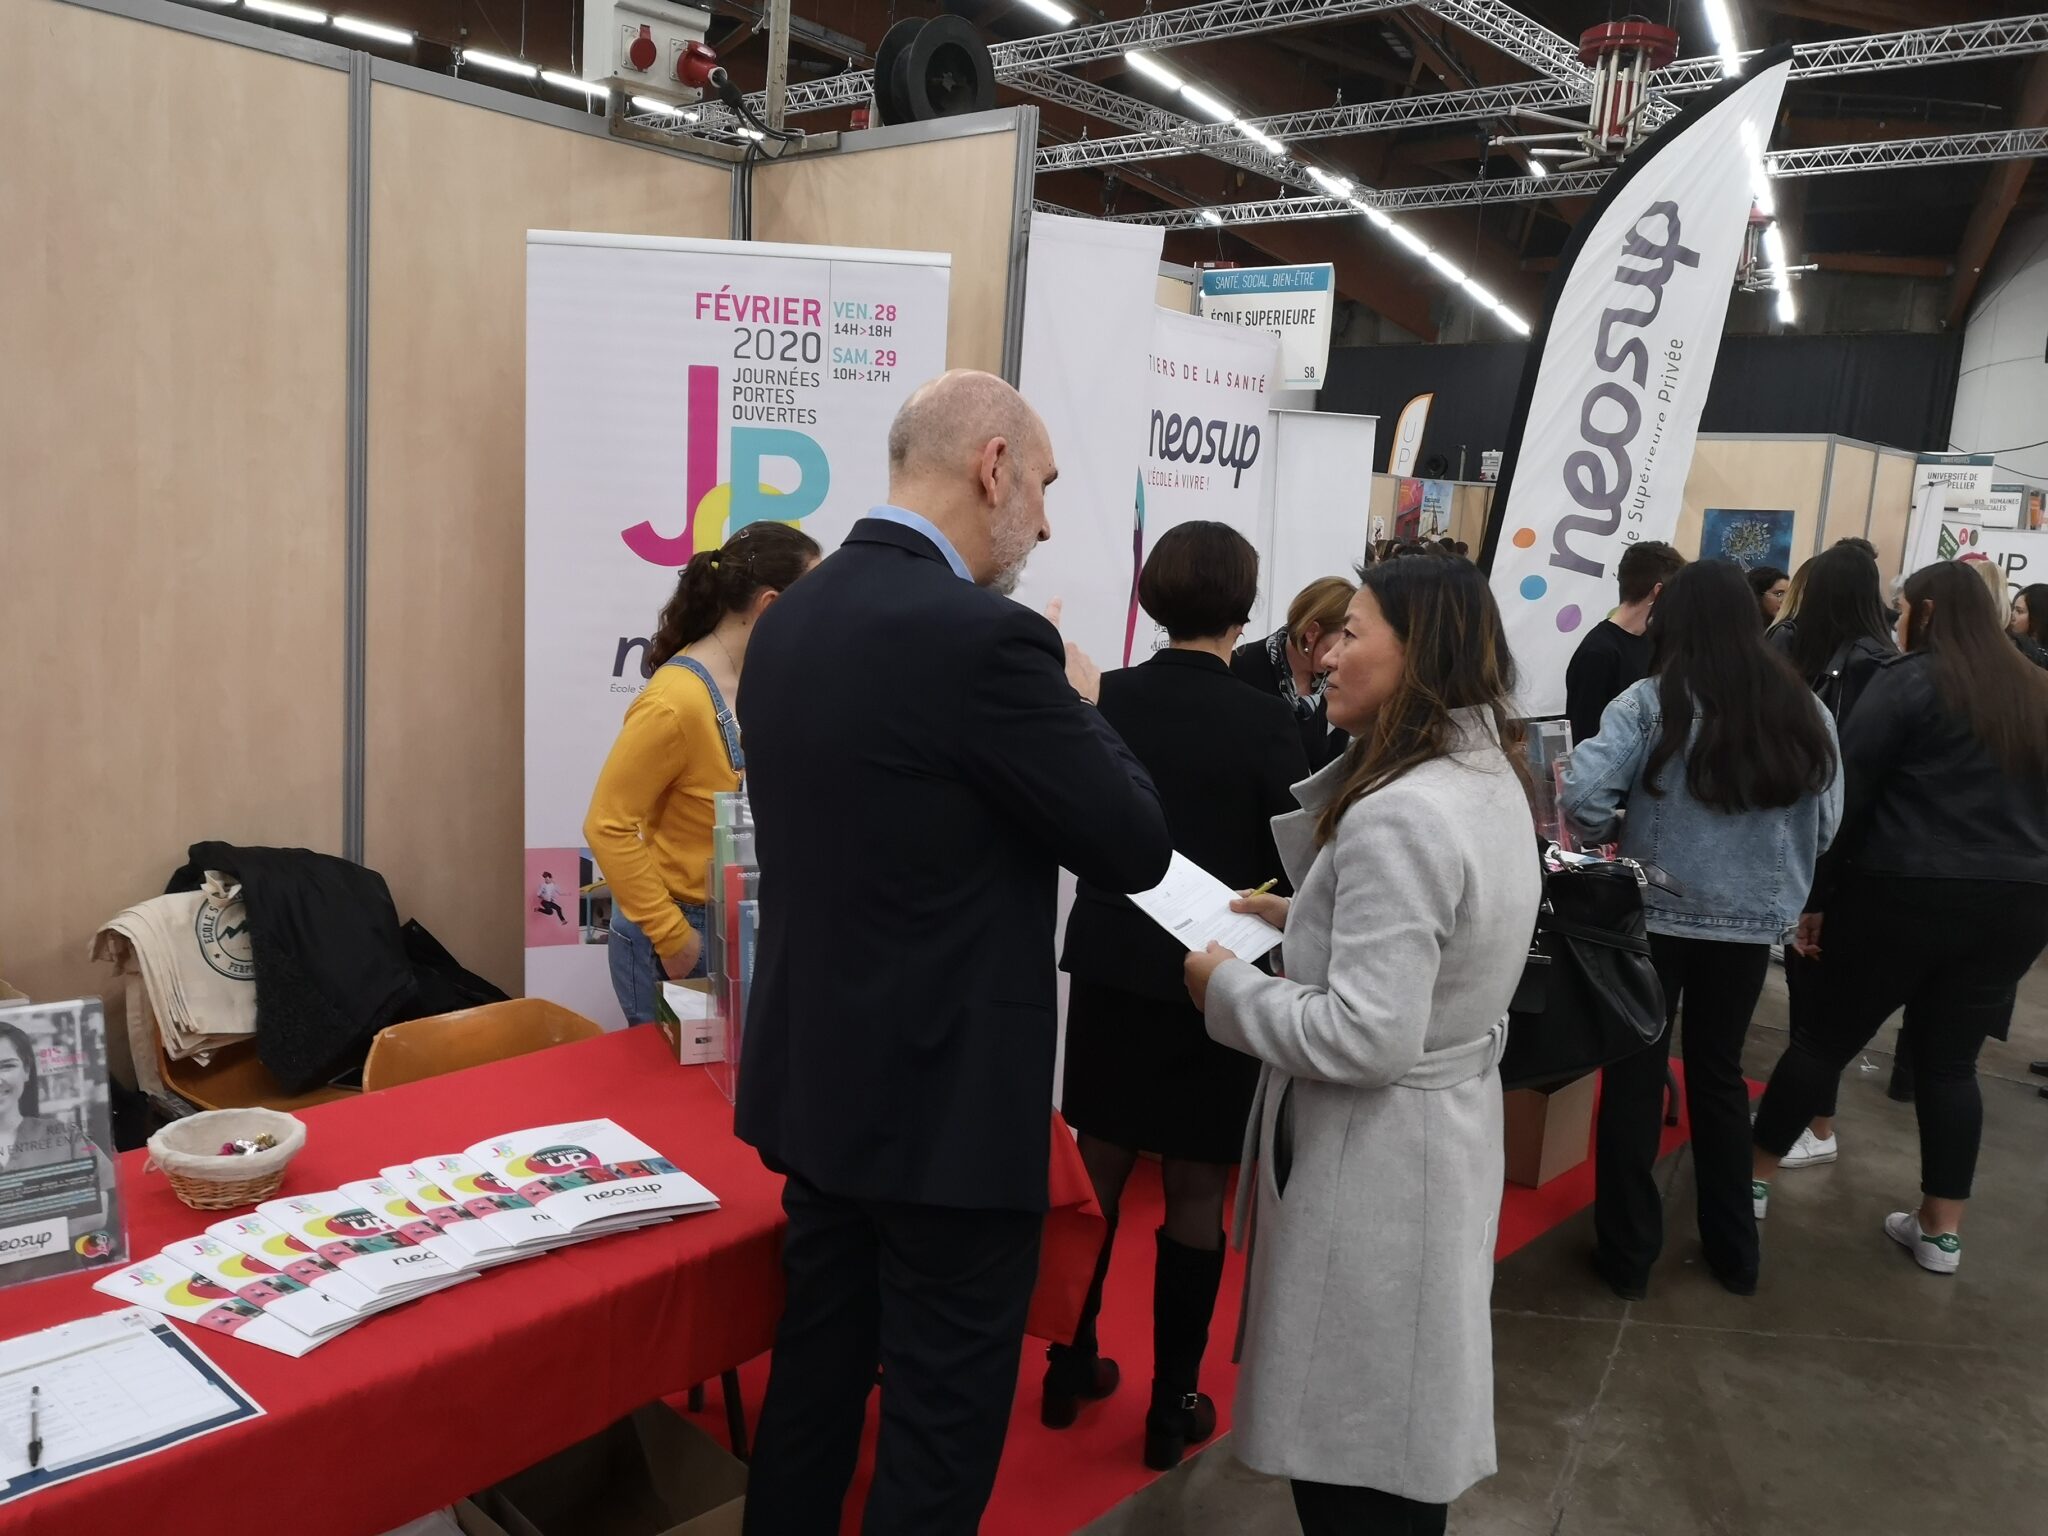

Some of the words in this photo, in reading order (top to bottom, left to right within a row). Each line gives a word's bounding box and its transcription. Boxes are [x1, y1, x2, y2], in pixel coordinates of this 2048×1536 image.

[1272, 270, 1315, 287] BIEN-ÊTRE
[695, 285, 821, 327] FÉVRIER
[1245, 308, 1316, 327] SUPERIEURE
[734, 327, 821, 363] 2020
[732, 366, 820, 388] JOURNÉES
[1183, 364, 1198, 381] DE
[1206, 368, 1219, 385] LA
[1227, 372, 1265, 393] SANTÉ
[1304, 366, 1315, 379] S8
[732, 386, 795, 405] PORTES
[1549, 201, 1700, 578] neosup
[732, 404, 817, 425] OUVERTES
[1628, 412, 1666, 523] Supérieure
[1657, 338, 1684, 403] Privée
[1149, 409, 1260, 489] neosup
[1927, 472, 1968, 481] UNIVERSITÉ
[1969, 473, 1979, 481] DE
[1947, 481, 1975, 490] PELLIER
[202, 914, 216, 944] ECOLE
[584, 1183, 662, 1203] neosup
[0, 1231, 52, 1251] eosup
[392, 1251, 438, 1265] neo
